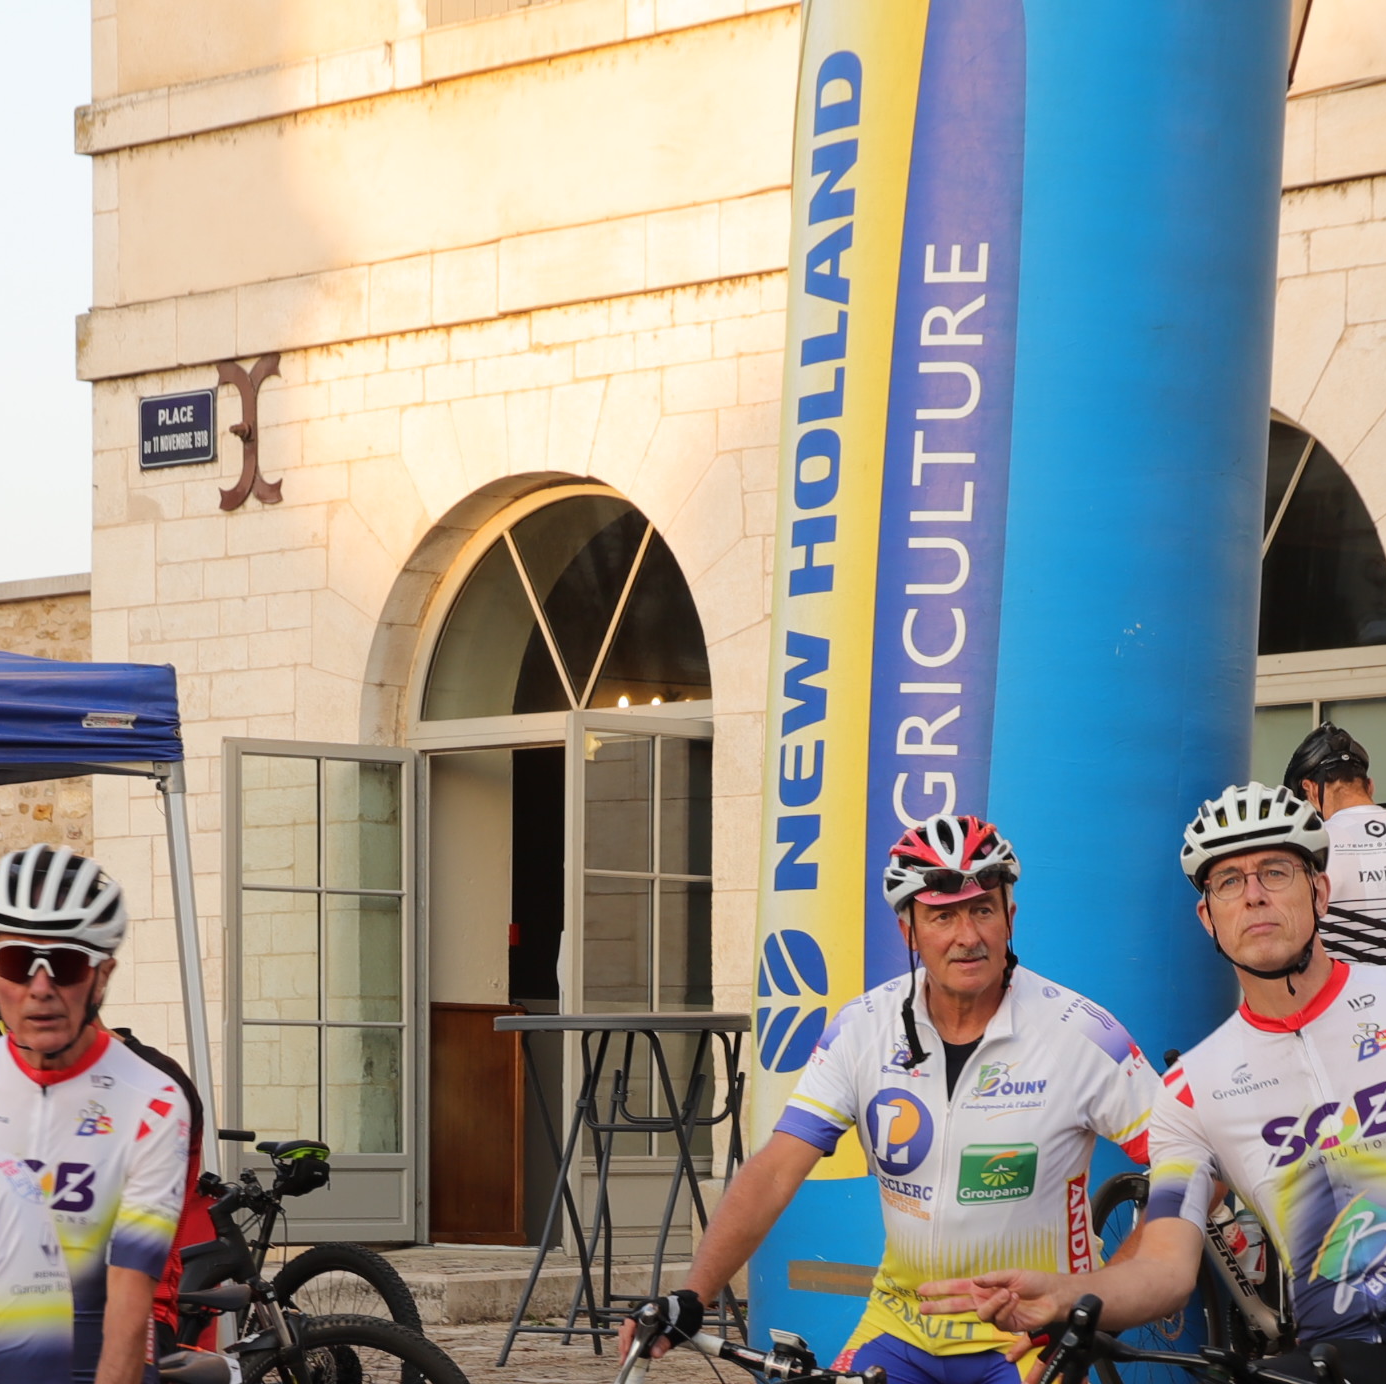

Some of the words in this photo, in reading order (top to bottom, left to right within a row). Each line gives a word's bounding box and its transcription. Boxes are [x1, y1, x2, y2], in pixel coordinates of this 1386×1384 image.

[789, 50, 862, 598] HOLLAND
[153, 437, 160, 453] 11
[160, 432, 193, 452] NOVEMBRE
[158, 405, 194, 426] PLACE
[892, 242, 990, 828] GRICULTURE
[774, 630, 830, 891] NEW
[1212, 1076, 1280, 1101] Groupama
[959, 1185, 1030, 1200] Groupama
[1070, 1183, 1090, 1273] ANDR
